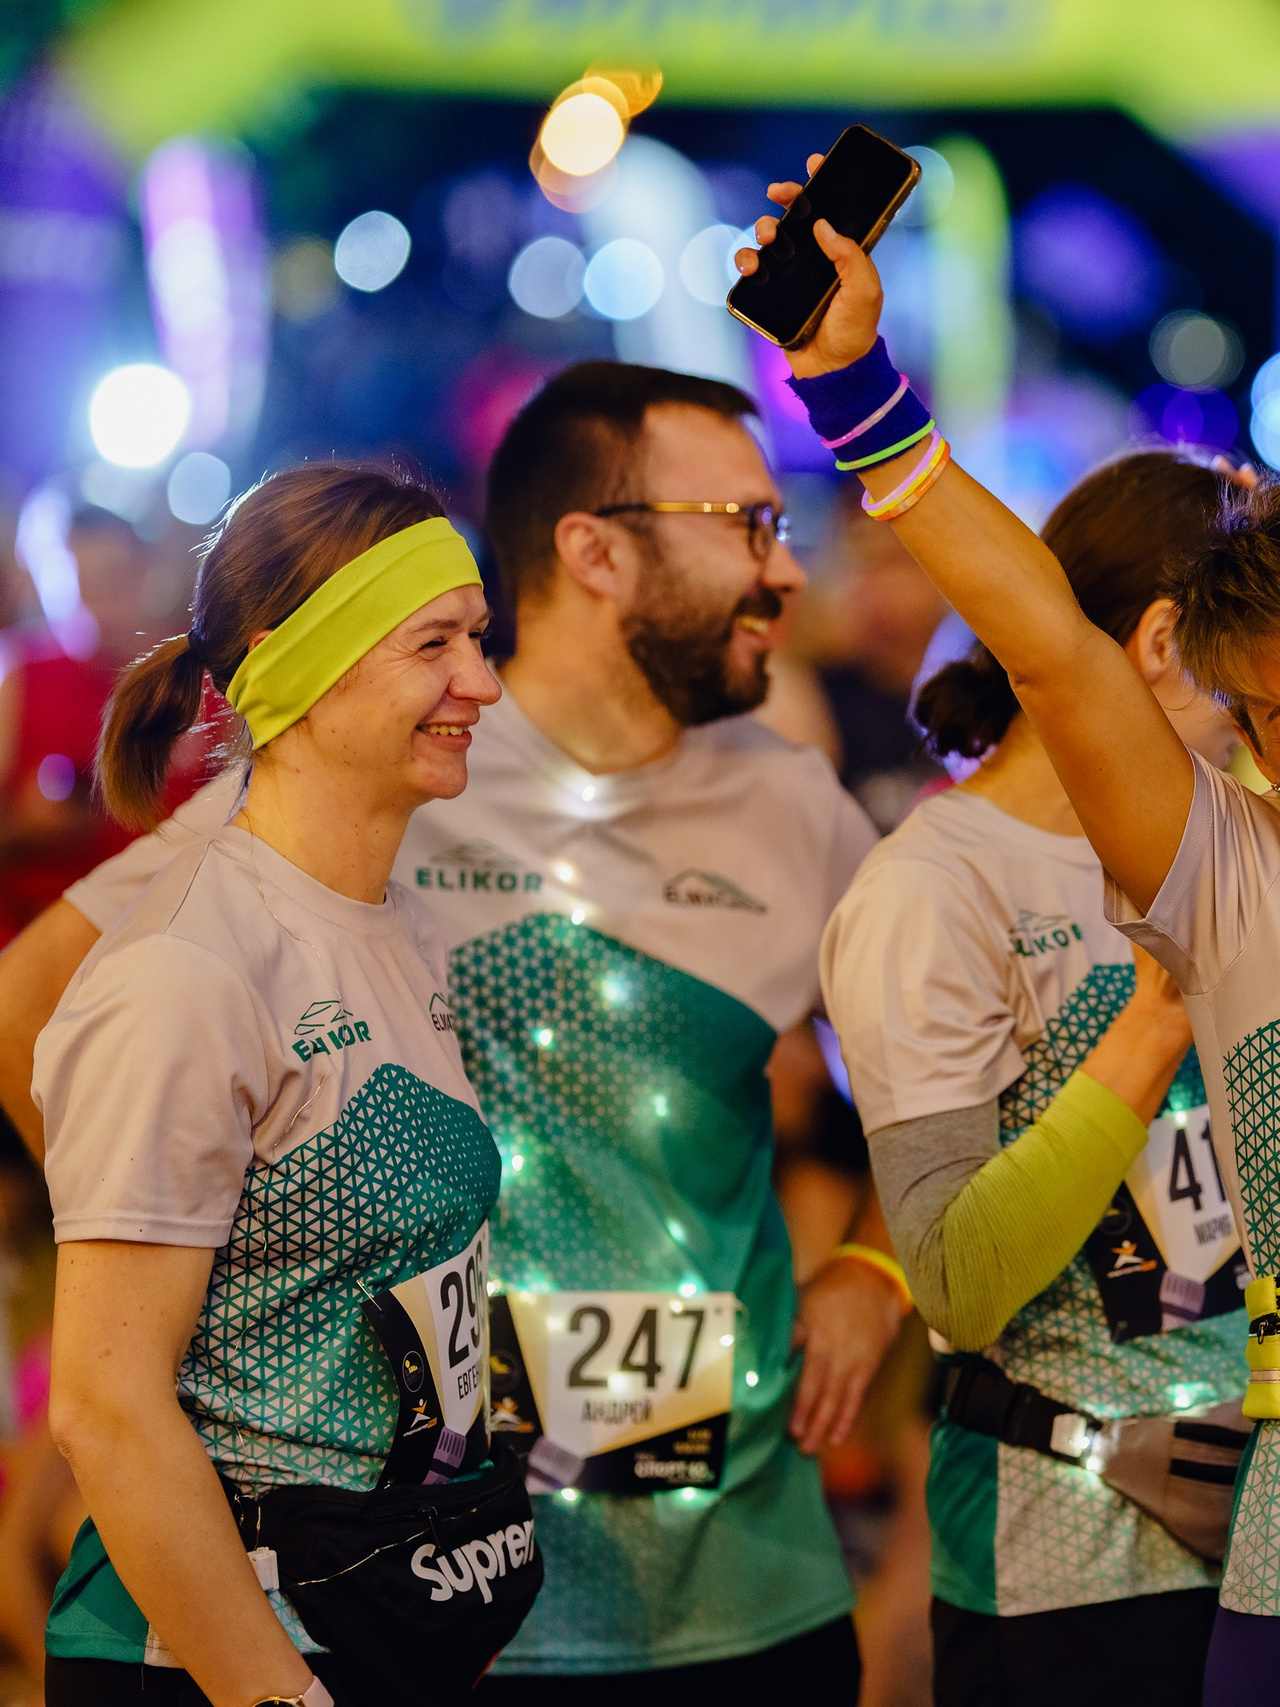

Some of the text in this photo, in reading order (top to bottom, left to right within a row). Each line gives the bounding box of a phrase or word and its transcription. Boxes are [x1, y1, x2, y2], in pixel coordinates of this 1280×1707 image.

[415, 866, 543, 894] ELIKOR
[292, 1020, 372, 1062] EIOR
[567, 1305, 705, 1392] 247
